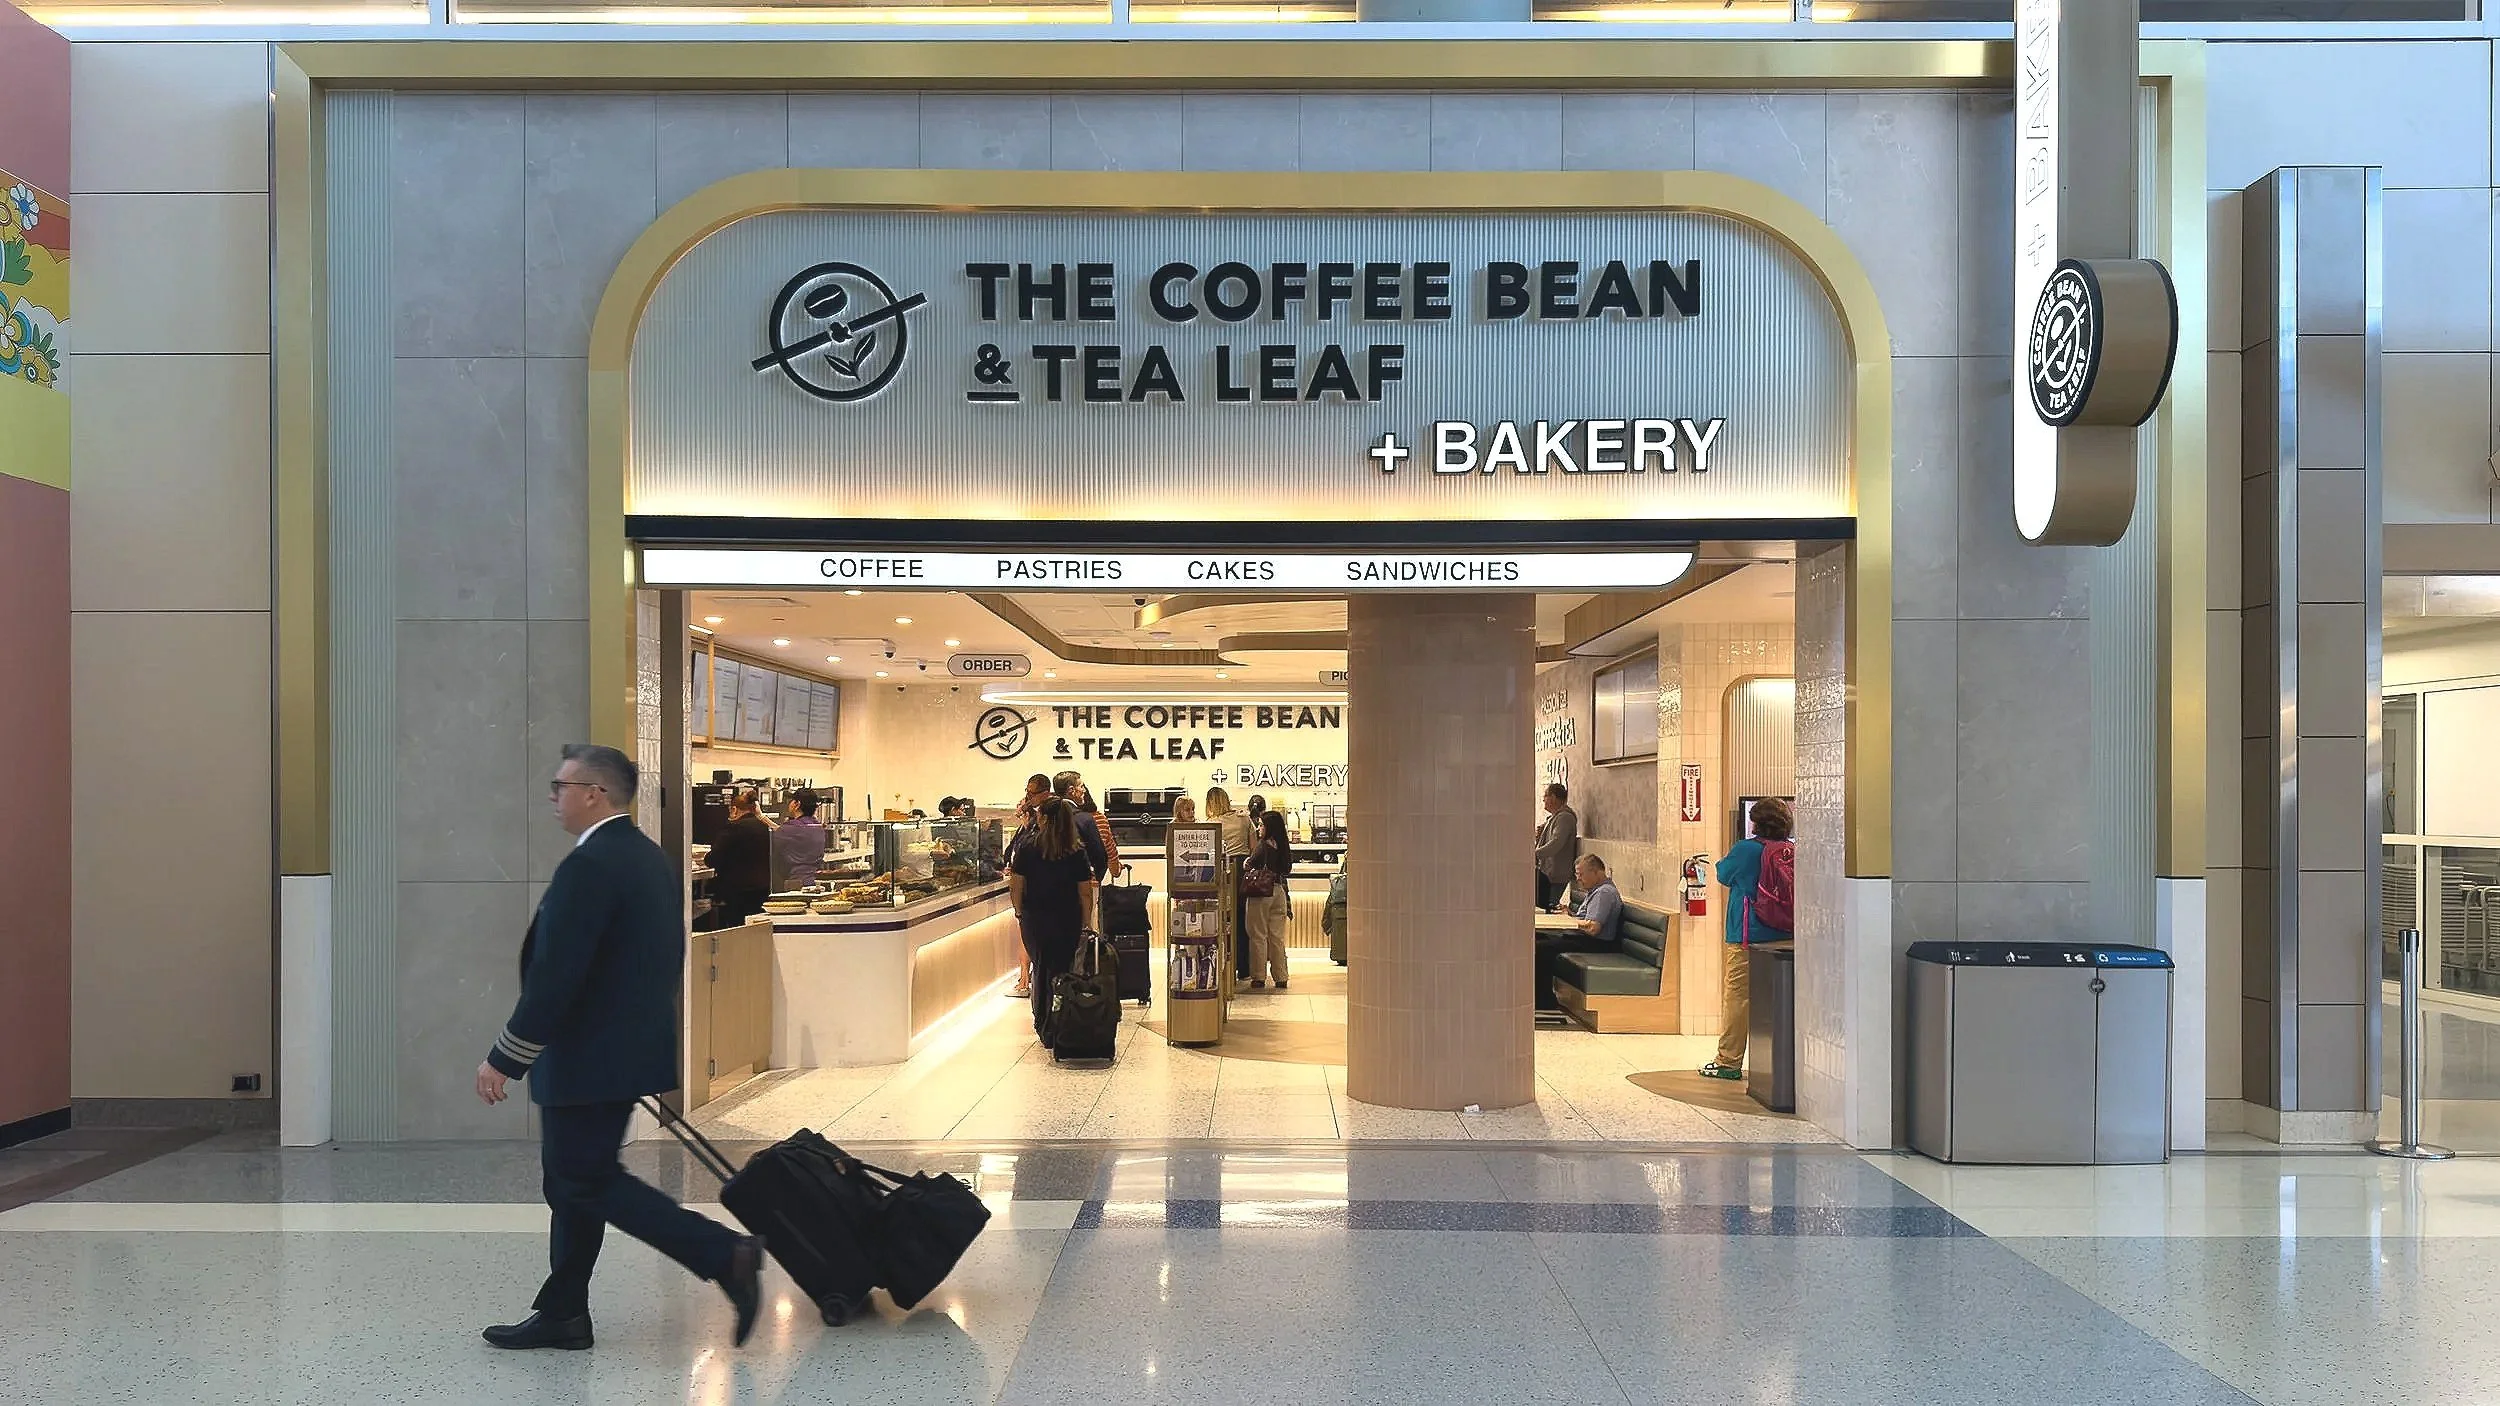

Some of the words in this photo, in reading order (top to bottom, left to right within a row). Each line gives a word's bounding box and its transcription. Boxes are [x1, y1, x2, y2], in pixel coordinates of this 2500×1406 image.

[965, 262, 1115, 321] THE
[1149, 261, 1452, 321] COFFEE
[1487, 259, 1701, 319] BEAN
[2034, 290, 2056, 366] COFFEE
[2057, 279, 2082, 304] BEAN
[970, 343, 1016, 396] &
[1032, 344, 1186, 402] TEA
[1216, 344, 1405, 402] LEAF
[2049, 391, 2067, 409] TEA
[2068, 347, 2086, 397] LEAF
[1370, 432, 1409, 473] +
[1434, 417, 1727, 474] BAKERY
[820, 557, 925, 579] COFFEE
[996, 559, 1122, 580] PASTRIES
[1187, 559, 1275, 581] CAKES
[1346, 560, 1519, 582] SANDWICHES
[962, 658, 1013, 672] ORDER
[1052, 706, 1111, 729] THE
[1124, 705, 1244, 729] COFFEE
[1256, 705, 1341, 729] BEAN
[1055, 738, 1072, 757] &
[1080, 737, 1137, 760] TEA
[1150, 737, 1226, 760] LEAF
[1210, 768, 1229, 786] +
[1236, 764, 1348, 787] BAKERY
[1683, 768, 1699, 777] FIRE
